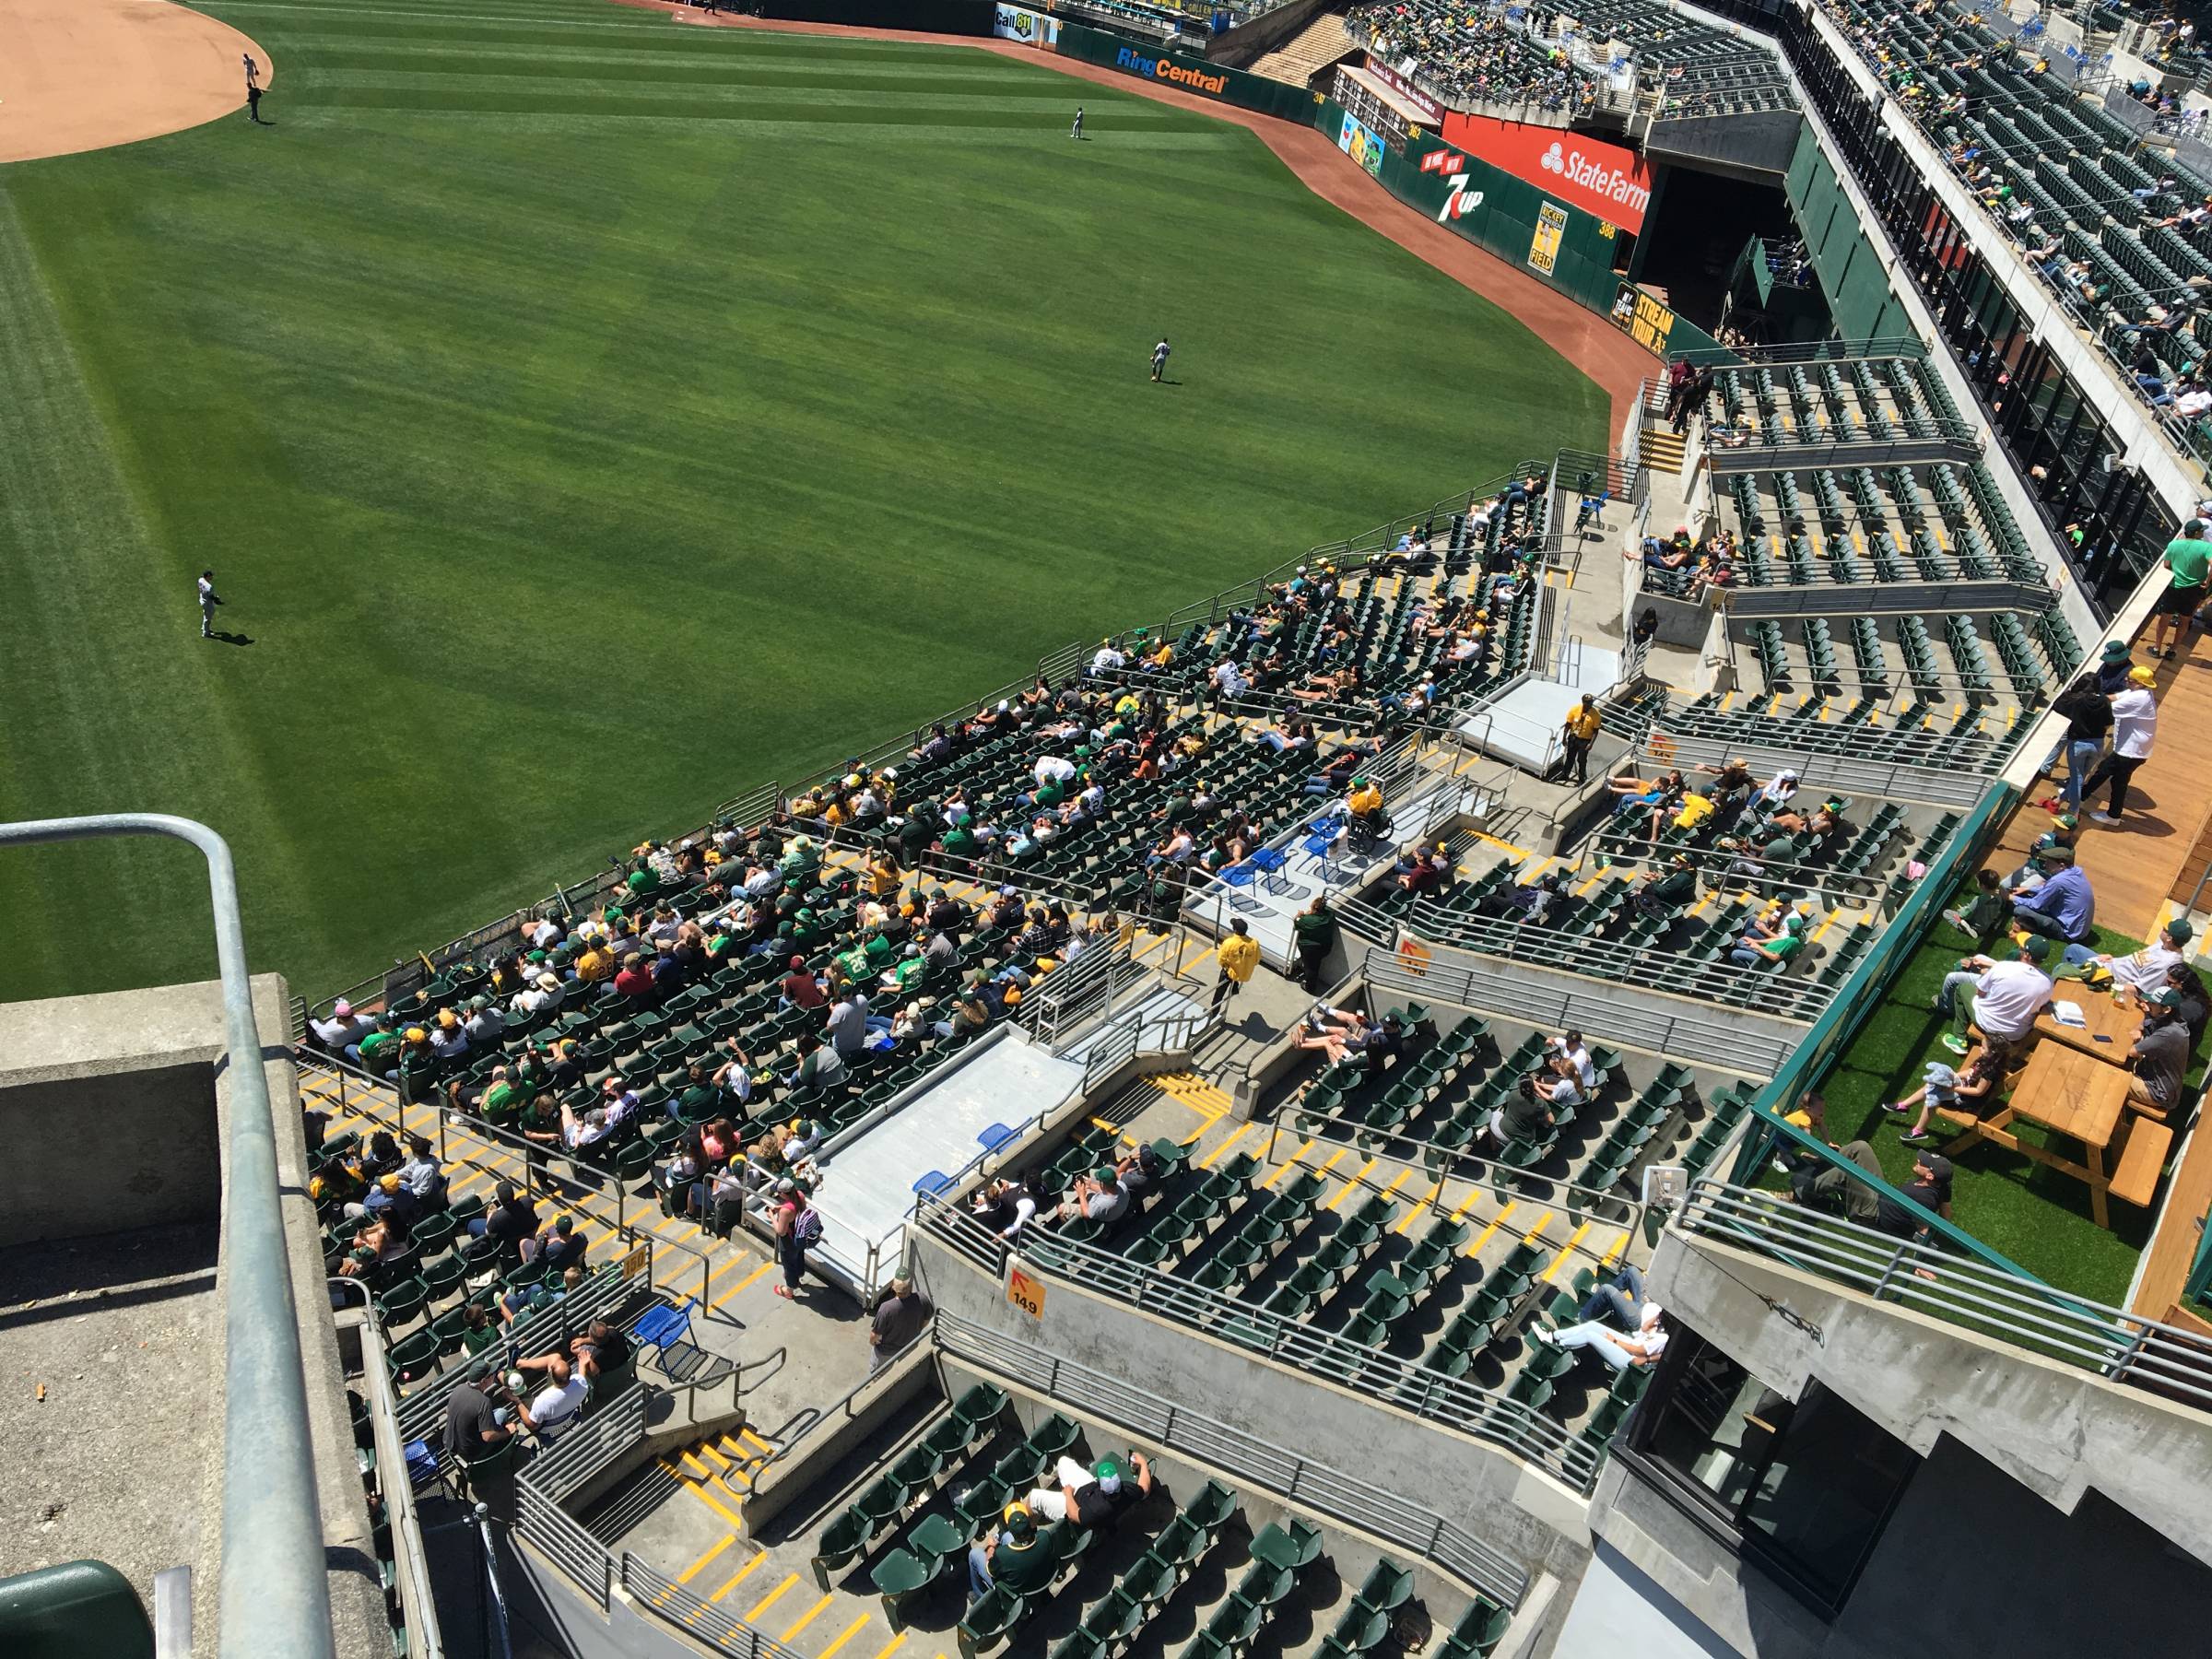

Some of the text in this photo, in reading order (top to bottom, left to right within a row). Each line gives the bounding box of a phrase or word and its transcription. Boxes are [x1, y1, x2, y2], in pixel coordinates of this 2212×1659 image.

[995, 12, 1015, 29] Call
[1017, 13, 1032, 30] 811
[1117, 47, 1226, 94] RingCentral
[1408, 124, 1421, 140] 362
[1542, 206, 1565, 223] RICKEY
[1599, 221, 1616, 240] 388
[1531, 249, 1552, 270] FIELD
[1636, 294, 1675, 335] STREAM
[1631, 314, 1655, 348] YOUR
[850, 956, 866, 973] 26
[626, 1252, 644, 1276] 150
[1014, 1292, 1038, 1314] 149
